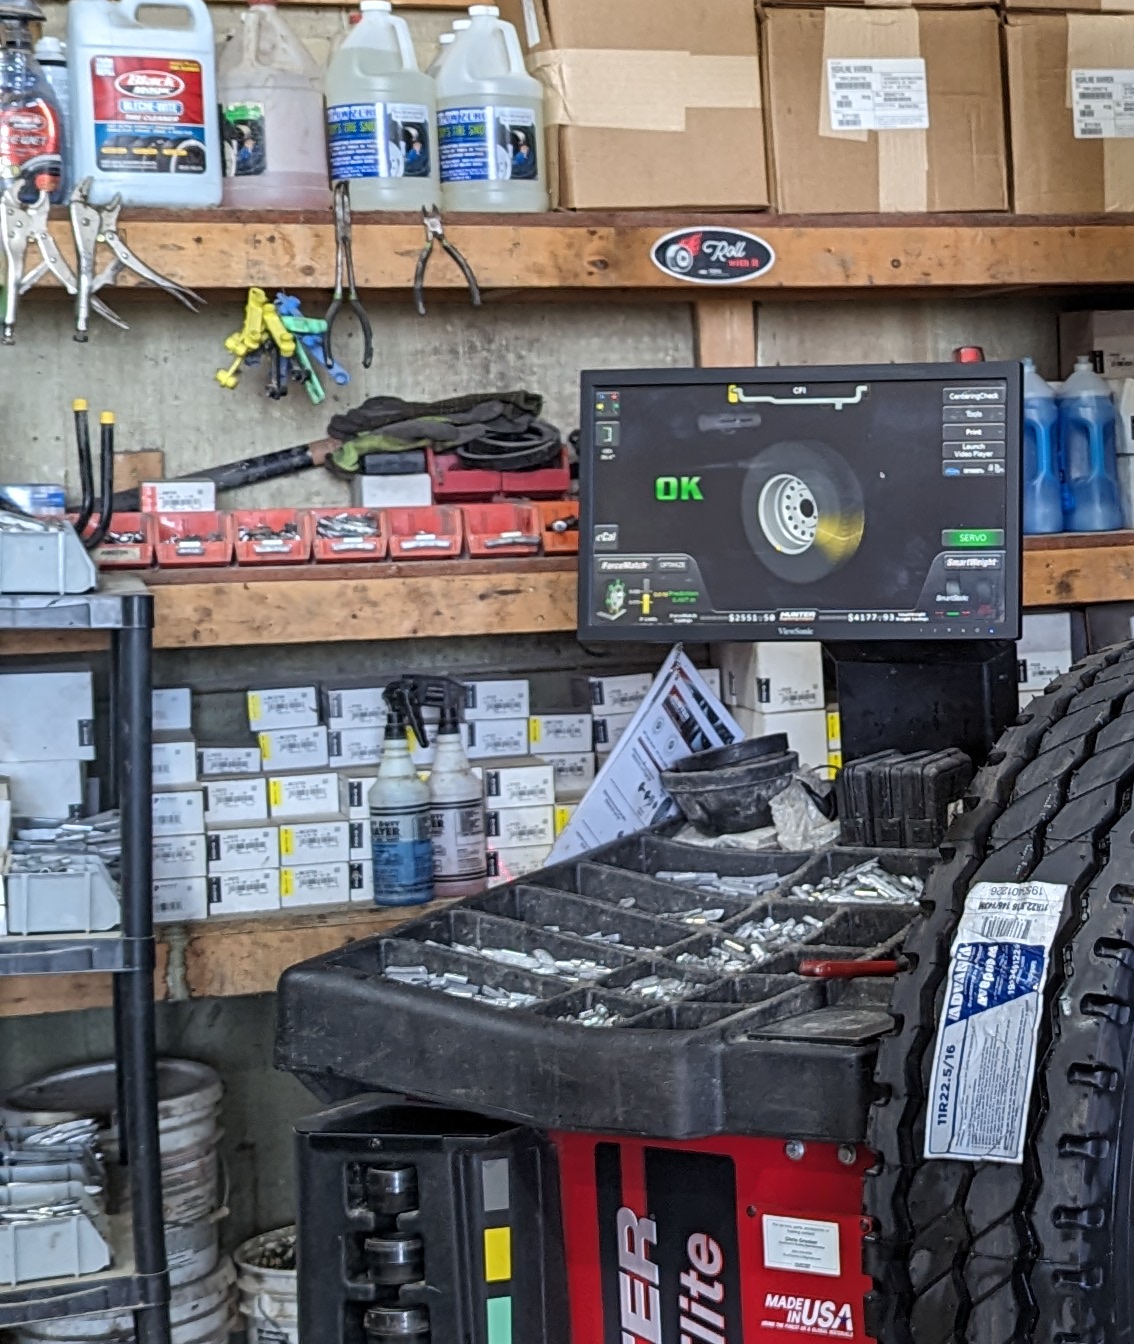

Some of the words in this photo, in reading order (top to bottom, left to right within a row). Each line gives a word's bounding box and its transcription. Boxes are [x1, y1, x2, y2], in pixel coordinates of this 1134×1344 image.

[702, 240, 747, 262] Roll
[948, 392, 999, 401] CenteringCheck
[965, 410, 983, 418] Tools
[965, 428, 983, 436] Print
[962, 443, 986, 451] Launch
[973, 450, 994, 459] Player
[655, 476, 704, 501] OK
[959, 533, 987, 543] SERVO
[848, 613, 895, 623] $4177.93
[778, 627, 814, 635] ViewSonic
[937, 1044, 956, 1126] 11R22.5/16
[765, 1293, 803, 1310] MADE
[786, 1309, 802, 1323] IN
[801, 1298, 854, 1332] USA
